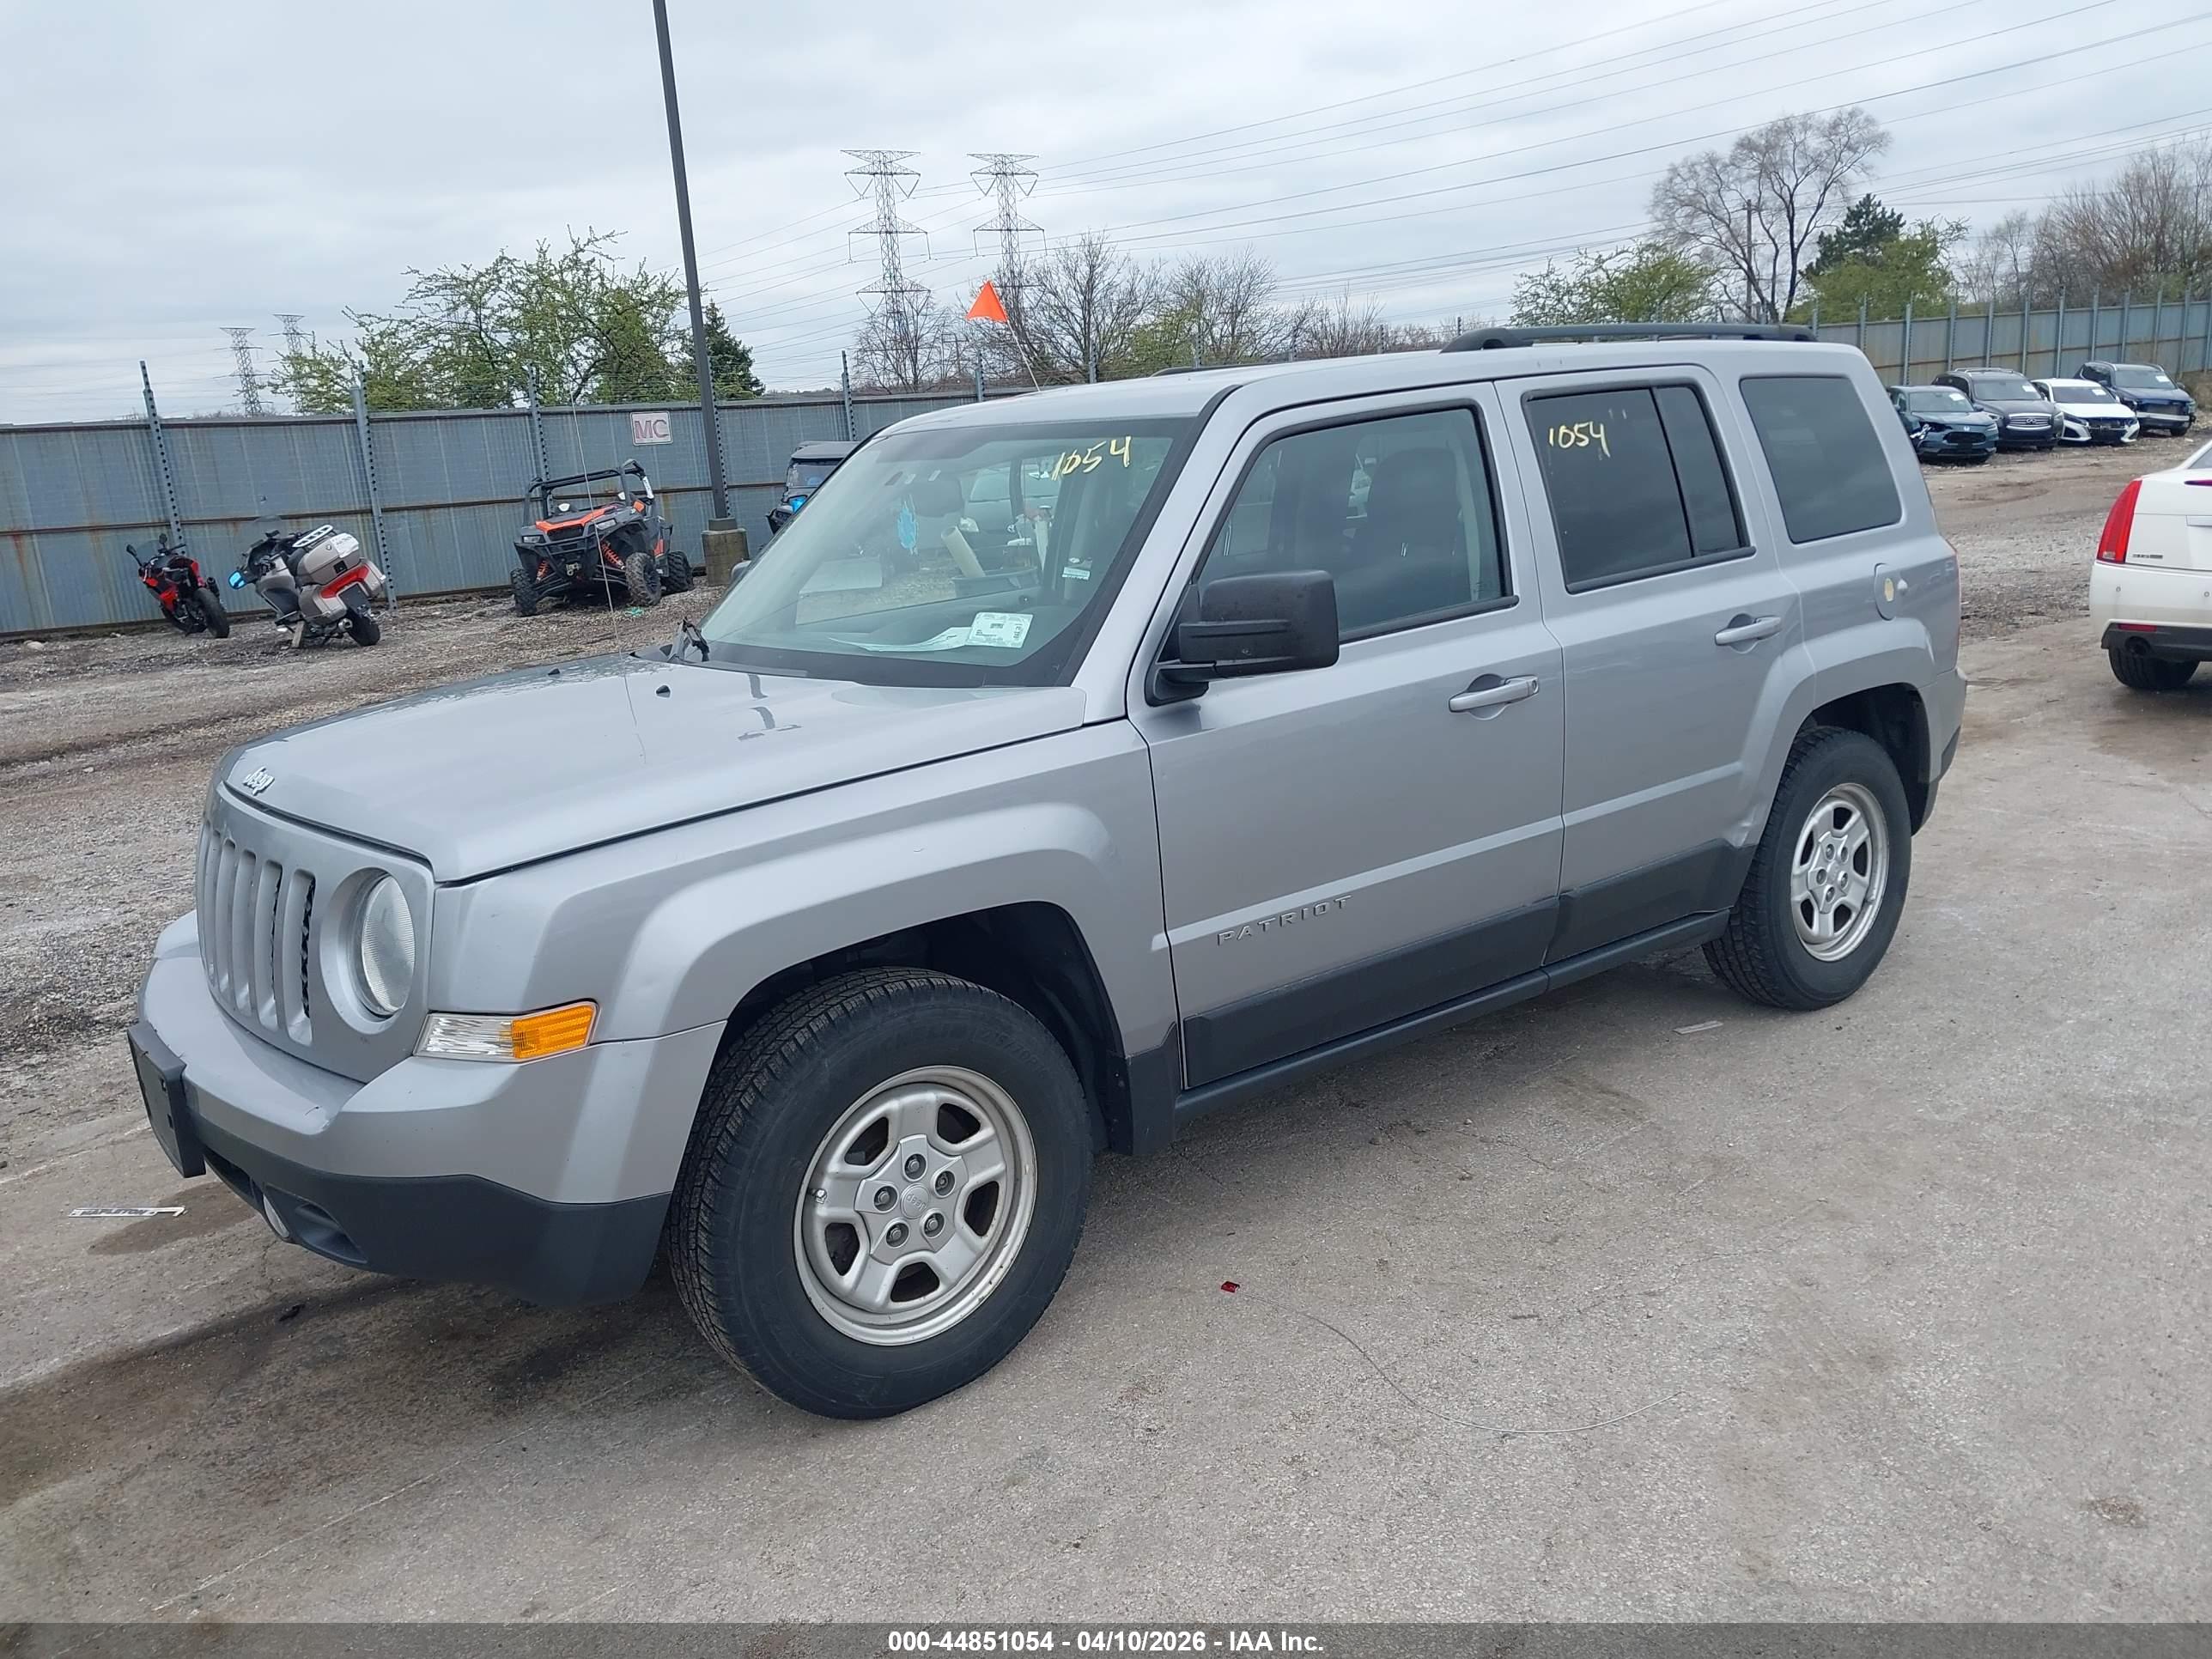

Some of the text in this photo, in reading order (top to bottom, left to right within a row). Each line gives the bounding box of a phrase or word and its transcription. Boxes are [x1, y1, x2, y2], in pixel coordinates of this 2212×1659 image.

[634, 419, 669, 439] MC
[1546, 421, 1611, 459] 1054
[1050, 435, 1132, 481] 1054
[243, 766, 275, 796] Jeep
[1217, 894, 1352, 946] PATRIOT
